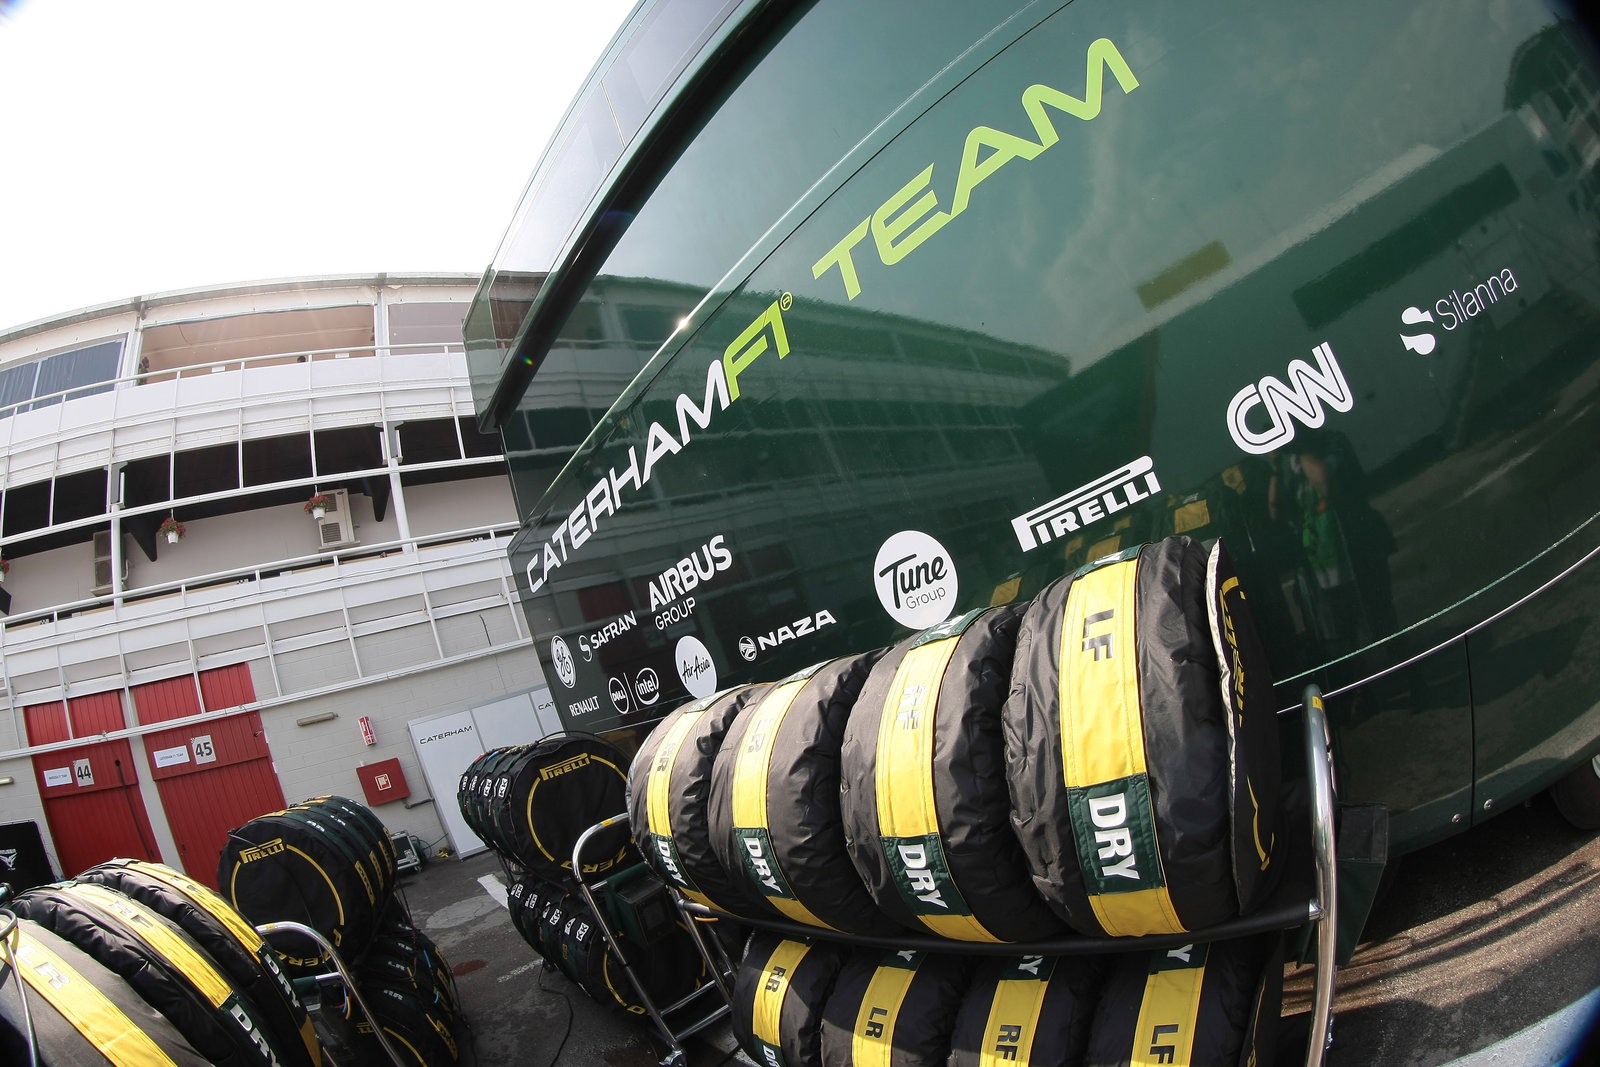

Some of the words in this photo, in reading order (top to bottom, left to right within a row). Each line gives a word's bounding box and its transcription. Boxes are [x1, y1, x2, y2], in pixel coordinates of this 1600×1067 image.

[811, 37, 1140, 302] TEAM
[1436, 267, 1519, 331] Silanna
[1226, 341, 1354, 454] CNN
[1010, 455, 1162, 552] PIRELLI
[649, 534, 733, 613] AIRBUS
[879, 553, 948, 609] Tune
[655, 596, 697, 631] GROUP
[905, 586, 947, 609] Group
[590, 609, 638, 650] SAFRAN
[759, 608, 838, 651] NAZA
[1081, 608, 1116, 663] LF
[568, 695, 600, 717] RENAULT
[611, 689, 627, 702] DELL
[636, 674, 657, 696] intel
[897, 683, 927, 731] RF
[195, 741, 214, 758] 45
[419, 725, 473, 745] CATERHAM
[77, 765, 92, 780] 44
[539, 752, 591, 781] PIRELLI
[239, 837, 285, 864] PIRELLI
[1088, 793, 1140, 879] DRY
[656, 838, 688, 887] DRY
[742, 836, 783, 895] DRY
[896, 843, 948, 909] DRY
[264, 953, 300, 1008] DRY
[765, 955, 787, 993] RR
[865, 1006, 889, 1040] LR
[995, 1024, 1023, 1062] RF
[1149, 1023, 1181, 1065] LF
